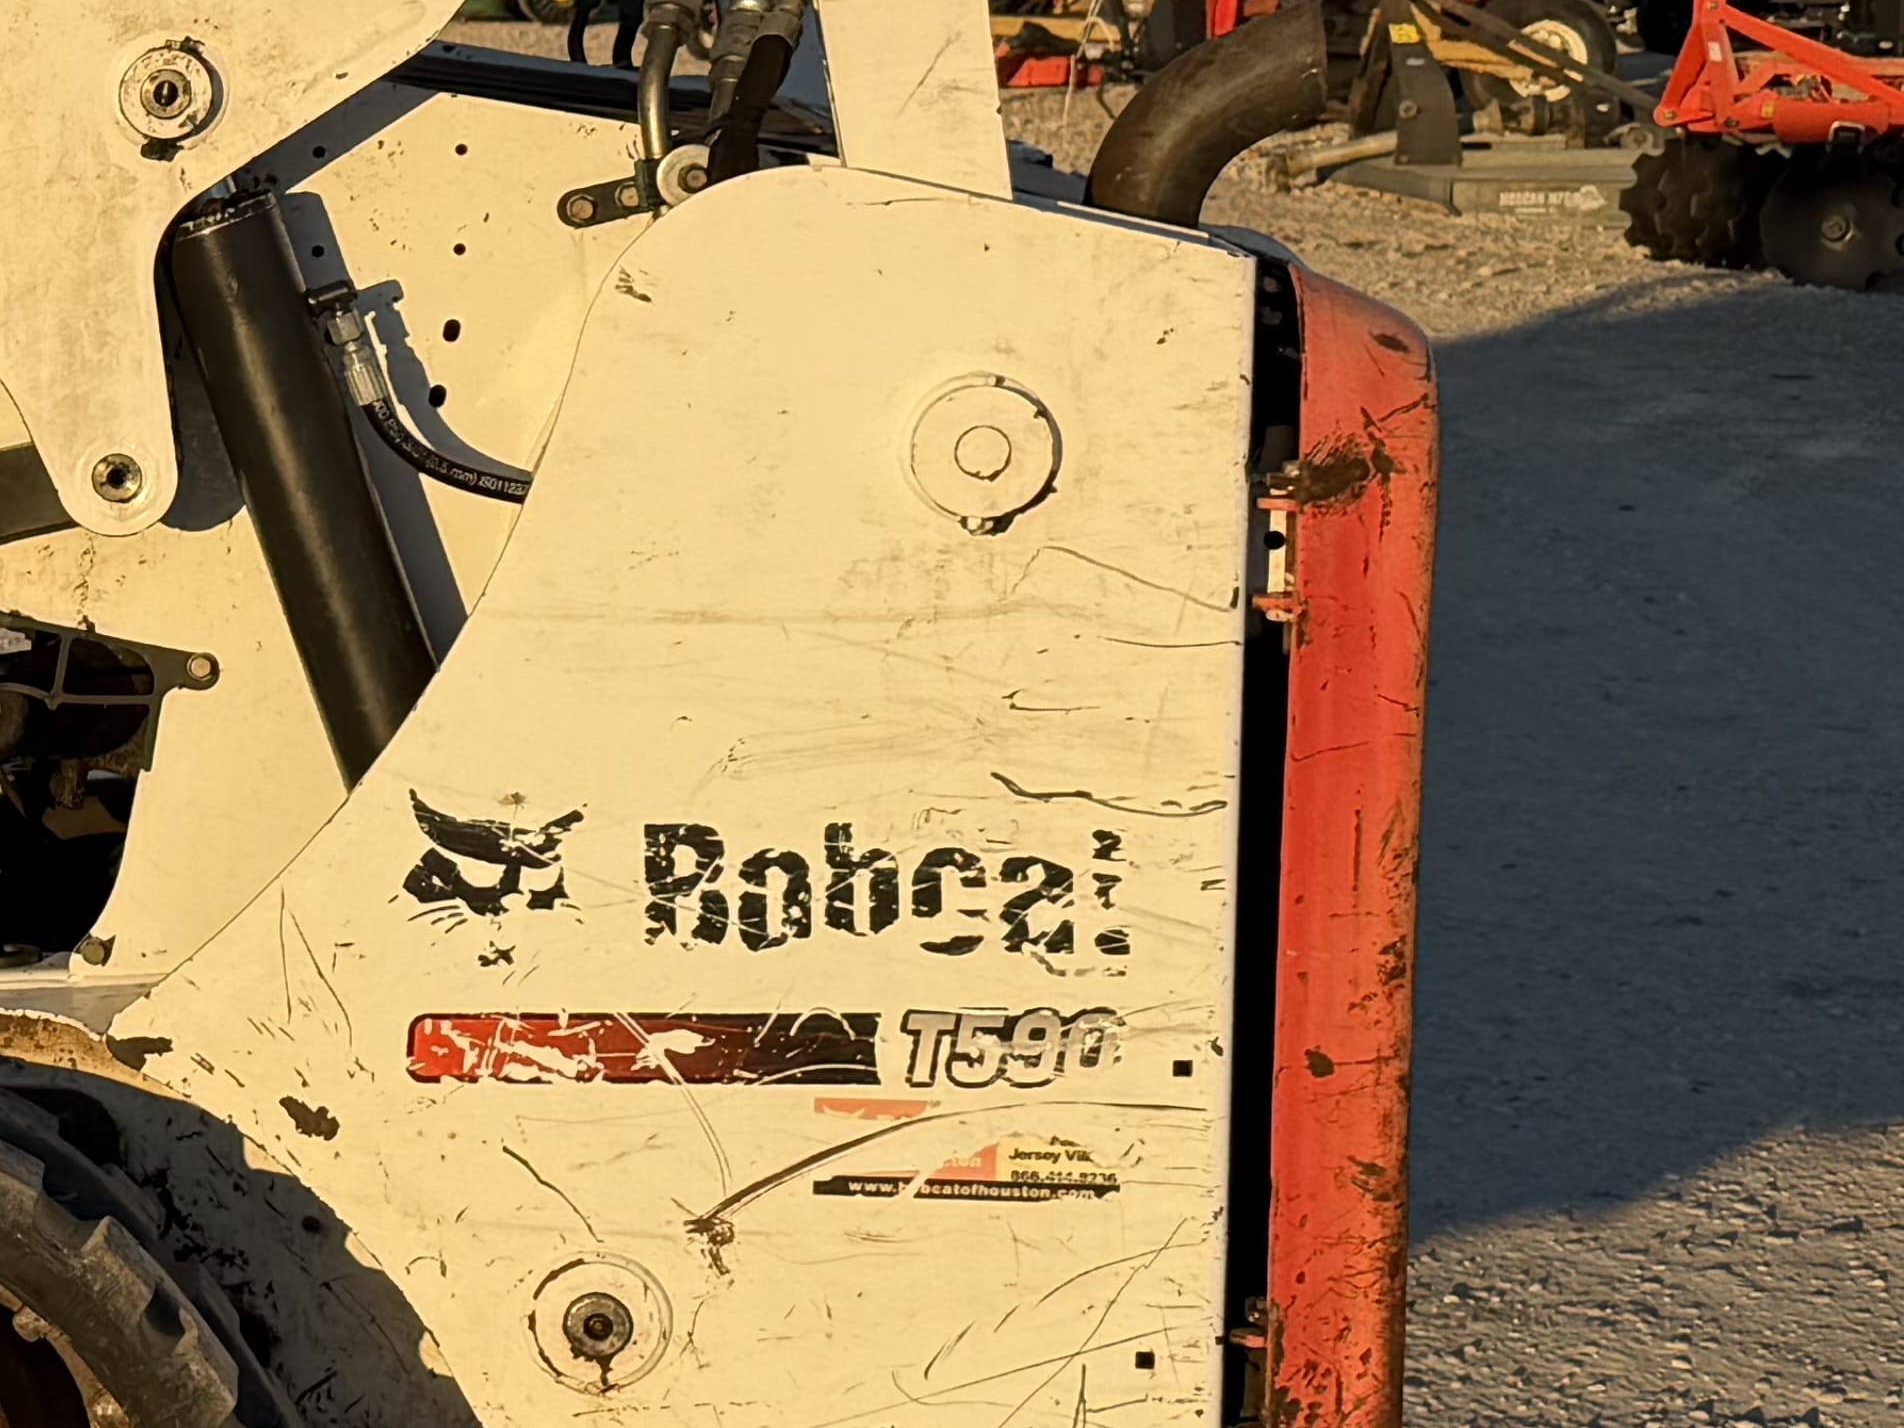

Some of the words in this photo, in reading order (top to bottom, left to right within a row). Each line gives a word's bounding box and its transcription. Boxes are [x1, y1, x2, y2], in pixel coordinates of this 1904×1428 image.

[901, 1008, 1126, 1088] T590
[1009, 1148, 1061, 1164] Jersey
[848, 1179, 1096, 1201] www.bbcatofhouston.com
